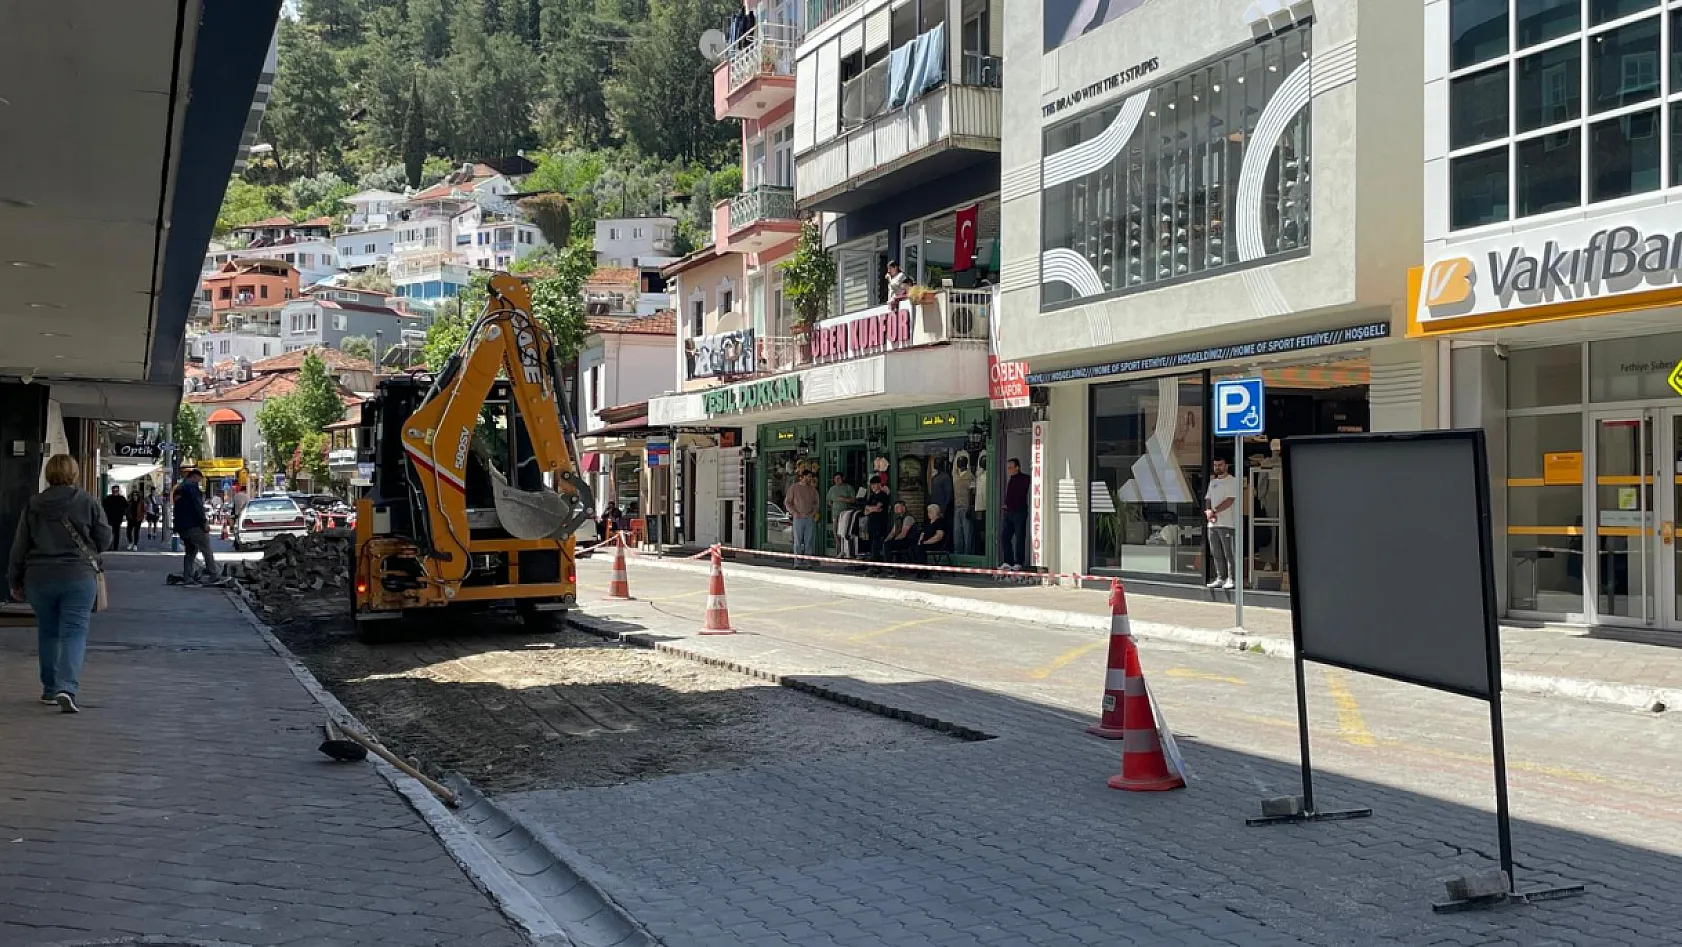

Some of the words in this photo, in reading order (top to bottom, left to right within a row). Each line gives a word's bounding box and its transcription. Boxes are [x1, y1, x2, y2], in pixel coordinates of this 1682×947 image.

[1056, 90, 1081, 111] BRAND
[1081, 80, 1103, 100] WITH
[1102, 74, 1120, 92] THE
[1125, 56, 1159, 82] STRIPES
[1120, 361, 1140, 372] SPORT
[1256, 341, 1267, 353] OF
[1268, 338, 1295, 351] SPORT
[1220, 385, 1250, 428] P
[121, 446, 153, 457] Optik
